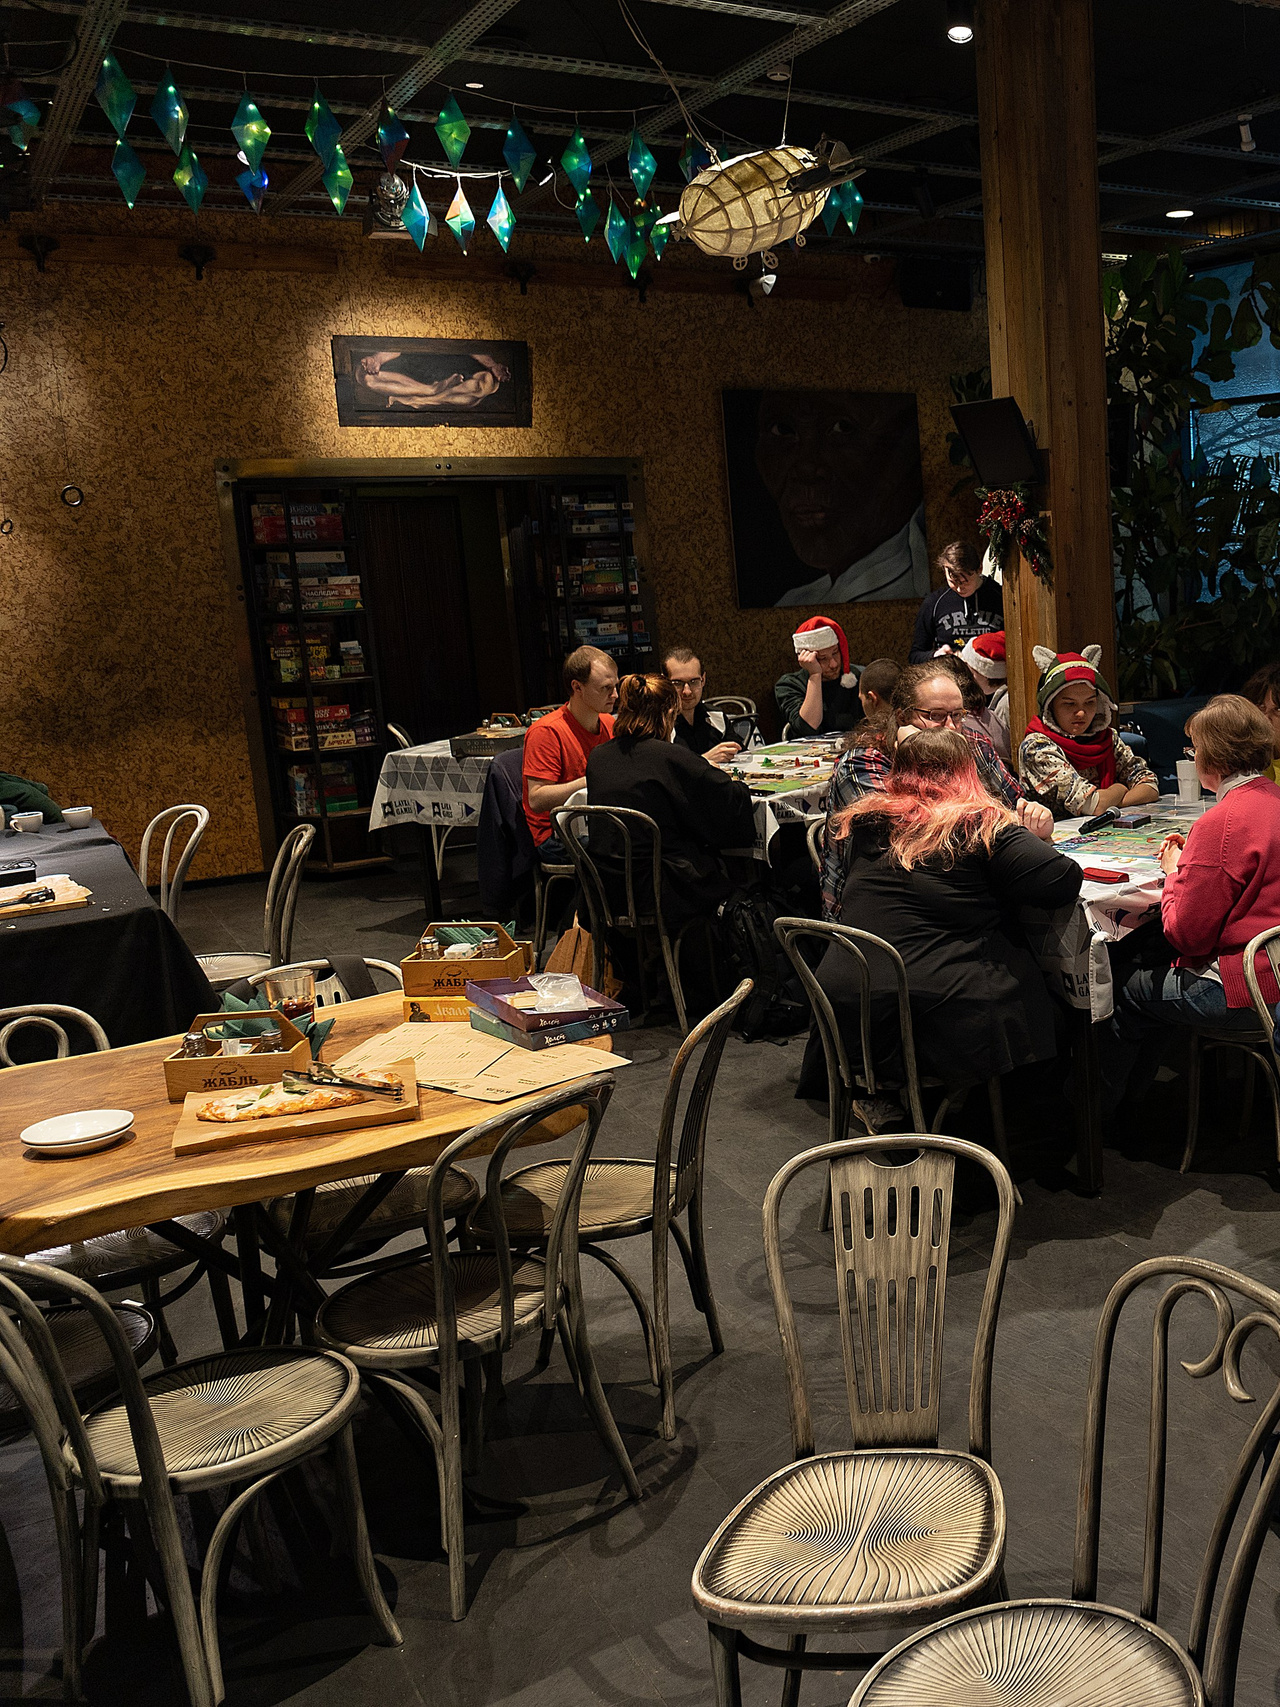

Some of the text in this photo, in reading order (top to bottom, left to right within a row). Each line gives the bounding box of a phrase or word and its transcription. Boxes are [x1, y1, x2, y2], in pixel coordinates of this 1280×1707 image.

[937, 610, 1004, 631] TRUE
[432, 978, 474, 988] ЖАБЛ
[202, 1075, 259, 1089] ЖАБЛЬ
